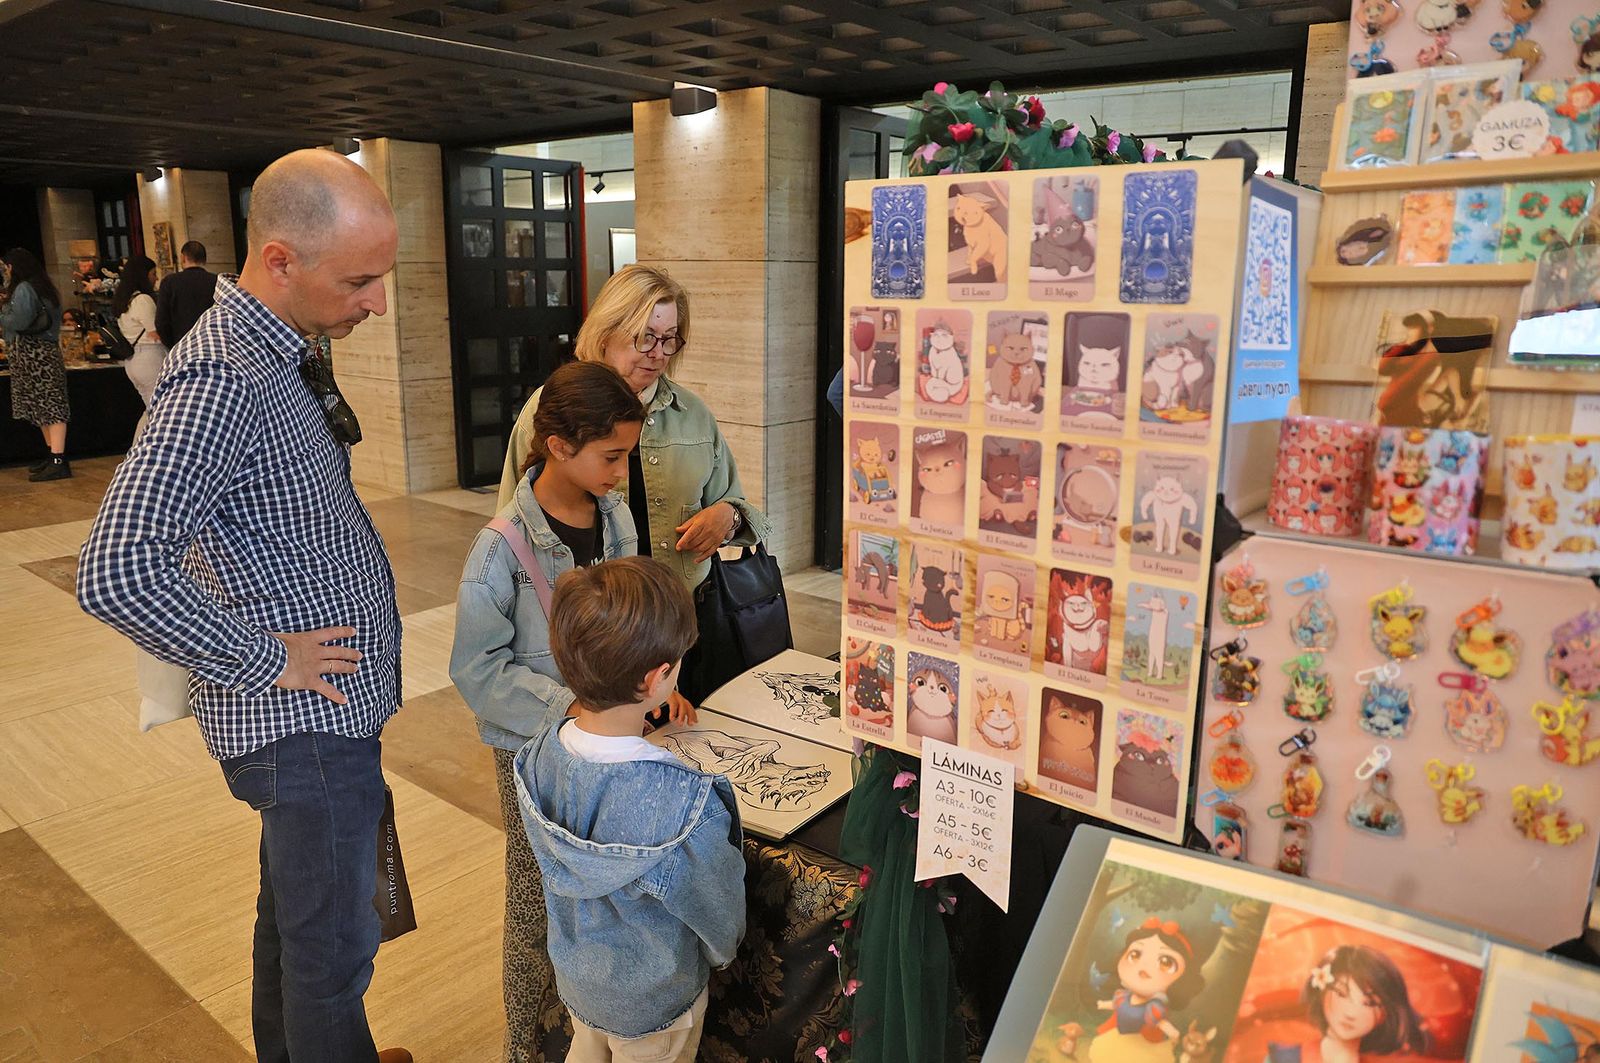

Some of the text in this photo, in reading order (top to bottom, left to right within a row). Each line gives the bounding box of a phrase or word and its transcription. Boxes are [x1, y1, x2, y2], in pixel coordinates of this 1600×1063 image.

[1480, 117, 1543, 132] GAMUZA
[1492, 134, 1525, 151] 3€
[961, 288, 991, 296] El Loco
[1044, 288, 1079, 298] El Mago
[860, 512, 888, 524] El Carro
[920, 523, 928, 531] La
[986, 535, 994, 543] El
[1142, 560, 1183, 575] La Fuerza
[856, 619, 886, 633] El Colgado
[1057, 669, 1092, 684] El Diablo
[1136, 689, 1170, 703] La Torre
[852, 720, 886, 736] La Estrella
[932, 752, 1003, 786] LÁMINAS
[935, 779, 955, 795] A3
[970, 789, 996, 809] 10€
[1049, 782, 1084, 800] El Juicio
[935, 794, 965, 810] OFERTA
[1125, 807, 1161, 825] El Mundo
[933, 826, 964, 842] OFERTA
[936, 812, 956, 828] A5
[971, 822, 992, 841] 5€
[933, 844, 953, 860] A6
[967, 854, 989, 873] 3€
[386, 824, 398, 915] puntroma.com
